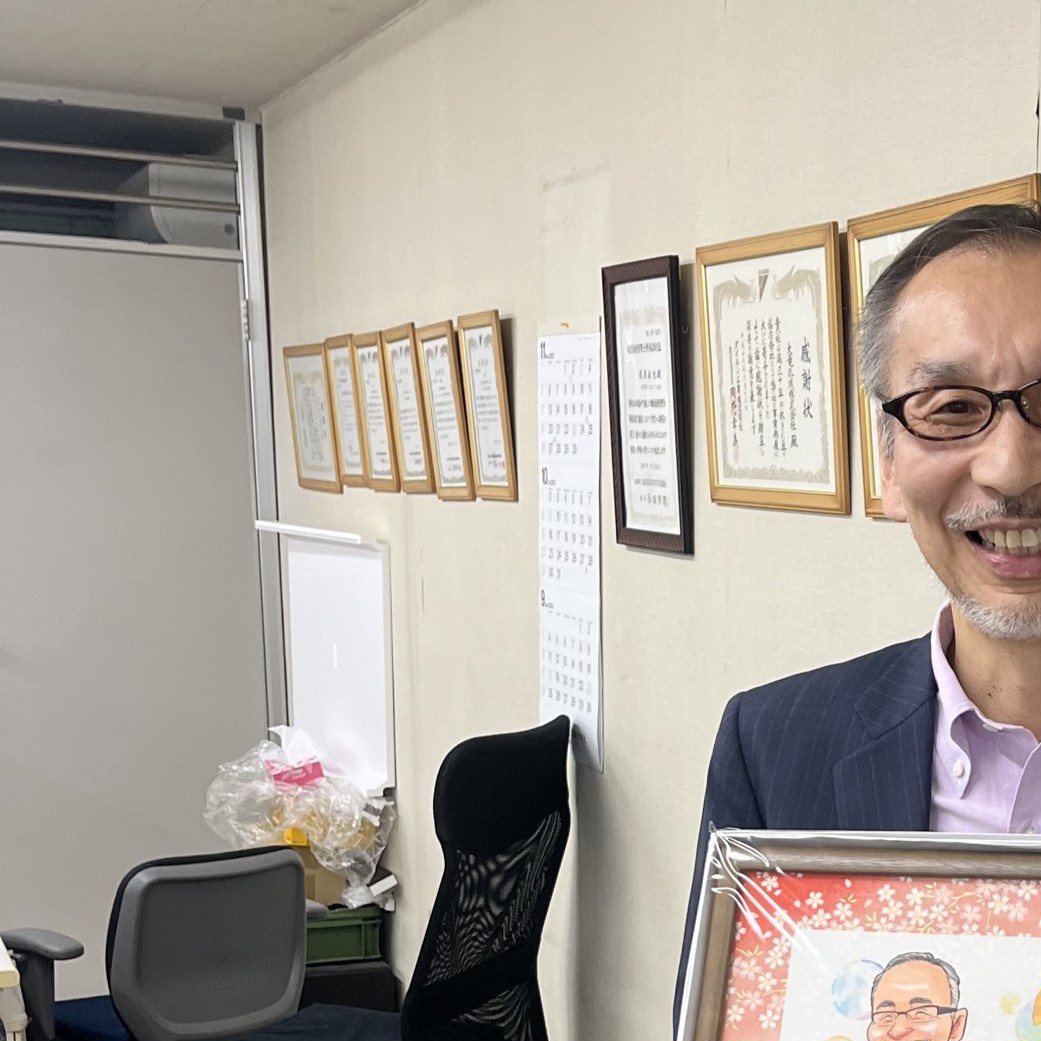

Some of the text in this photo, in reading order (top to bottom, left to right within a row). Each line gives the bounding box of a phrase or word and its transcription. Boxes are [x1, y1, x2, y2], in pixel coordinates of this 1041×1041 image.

[540, 341, 546, 359] 11
[801, 336, 813, 418] 感謝状
[541, 467, 548, 486] 10
[541, 589, 546, 607] 9
